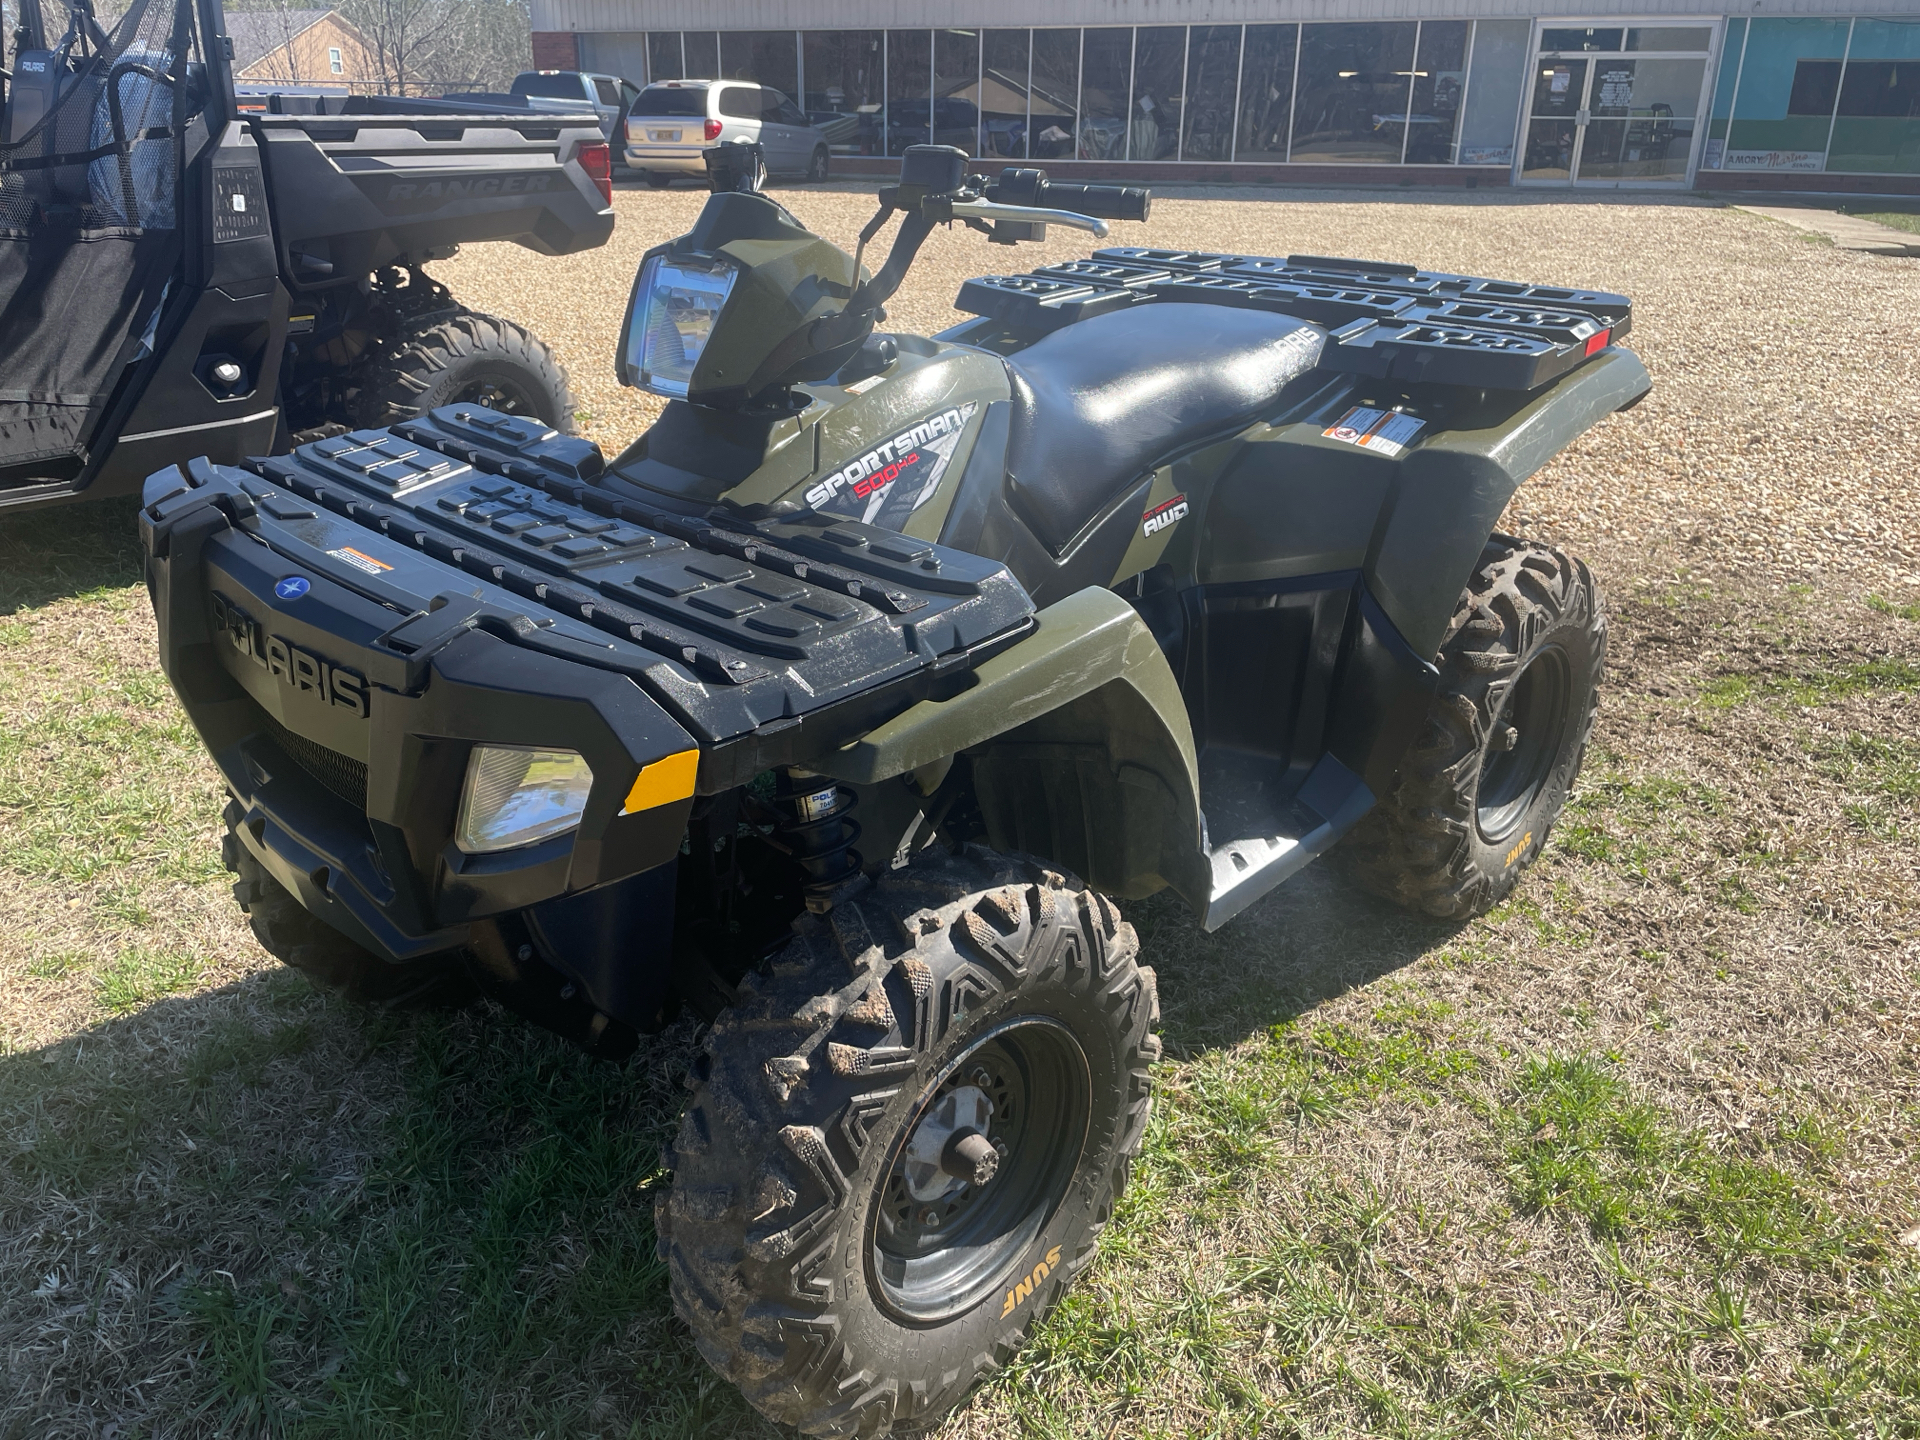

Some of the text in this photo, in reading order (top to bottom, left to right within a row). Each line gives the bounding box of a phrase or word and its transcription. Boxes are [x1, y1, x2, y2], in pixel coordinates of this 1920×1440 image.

[22, 61, 45, 72] POLARIS
[1727, 155, 1761, 165] AMORY
[386, 174, 551, 200] RANGER
[806, 409, 963, 510] SPORTSMAN
[853, 461, 898, 499] 500
[1143, 501, 1190, 538] AWD
[211, 590, 370, 719] POLARIS
[1505, 831, 1532, 869] SUNF
[1000, 1244, 1062, 1320] SUNF
